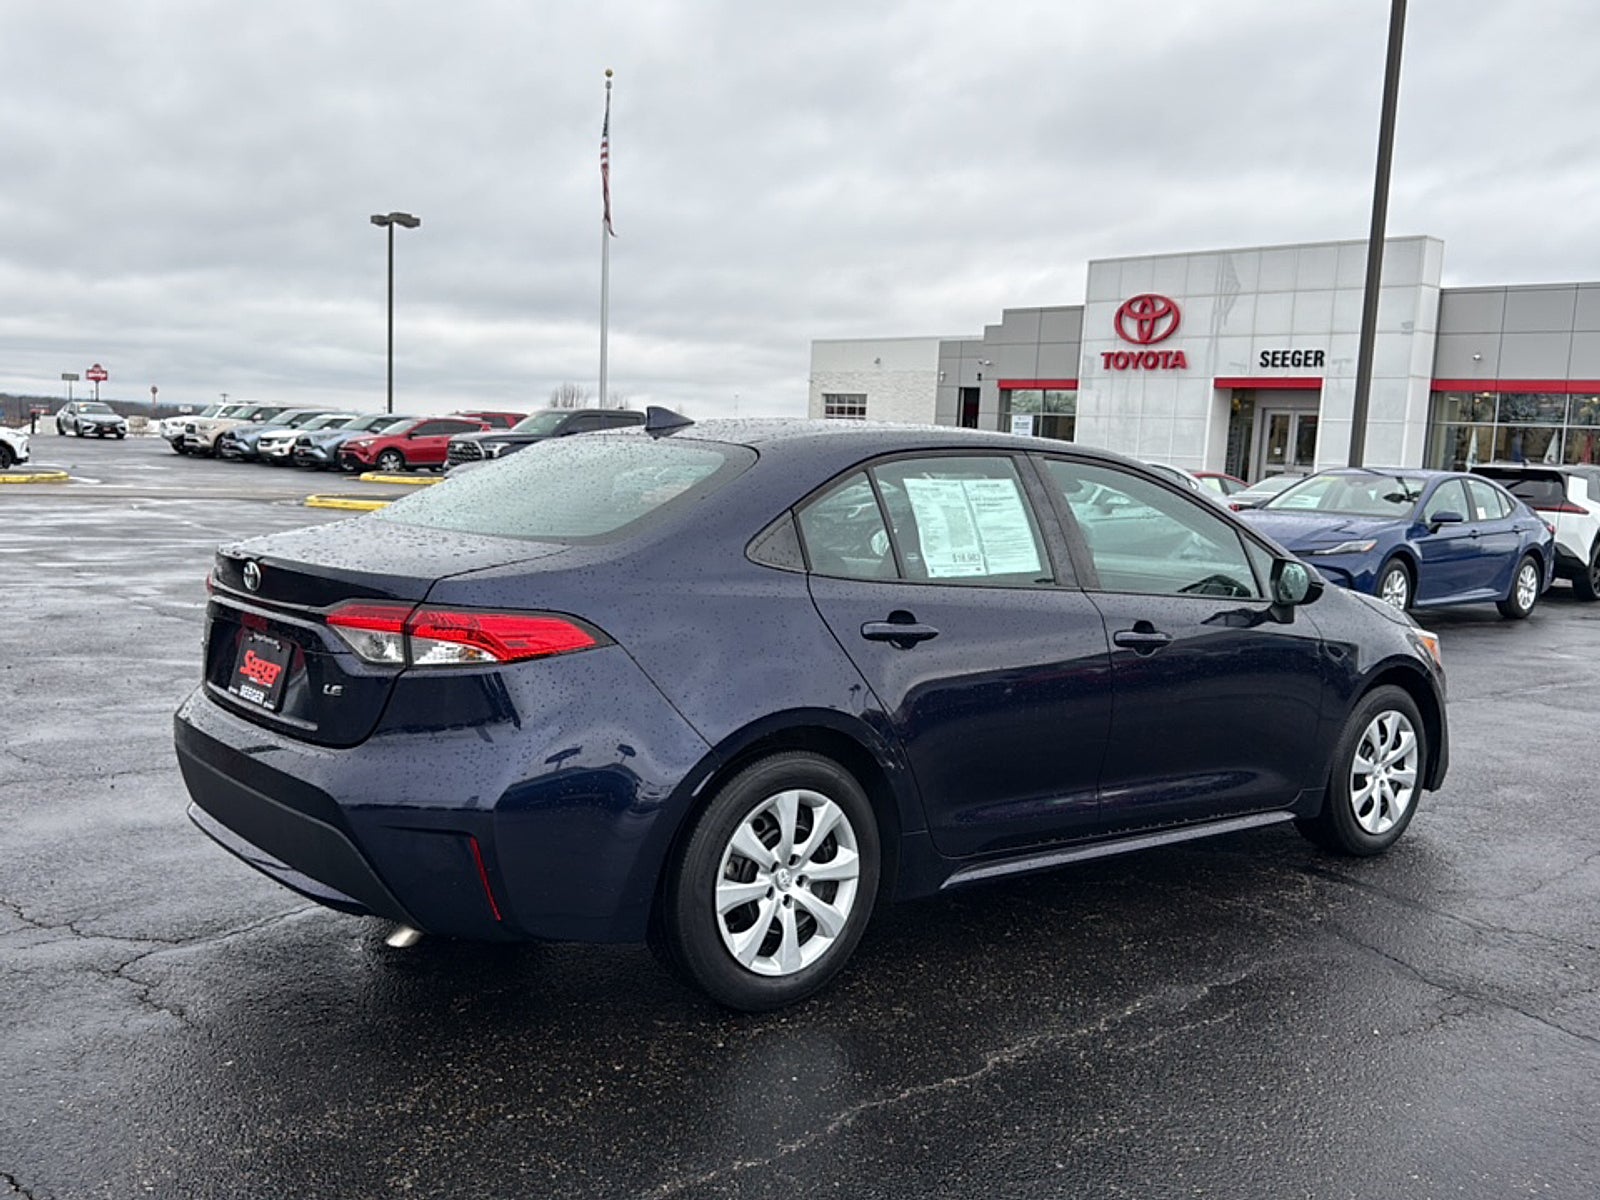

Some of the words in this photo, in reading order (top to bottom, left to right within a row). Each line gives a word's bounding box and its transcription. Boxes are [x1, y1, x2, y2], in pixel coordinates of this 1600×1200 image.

[1100, 351, 1188, 370] TOYOTA
[1259, 350, 1325, 368] SEEGER
[323, 683, 343, 696] LE
